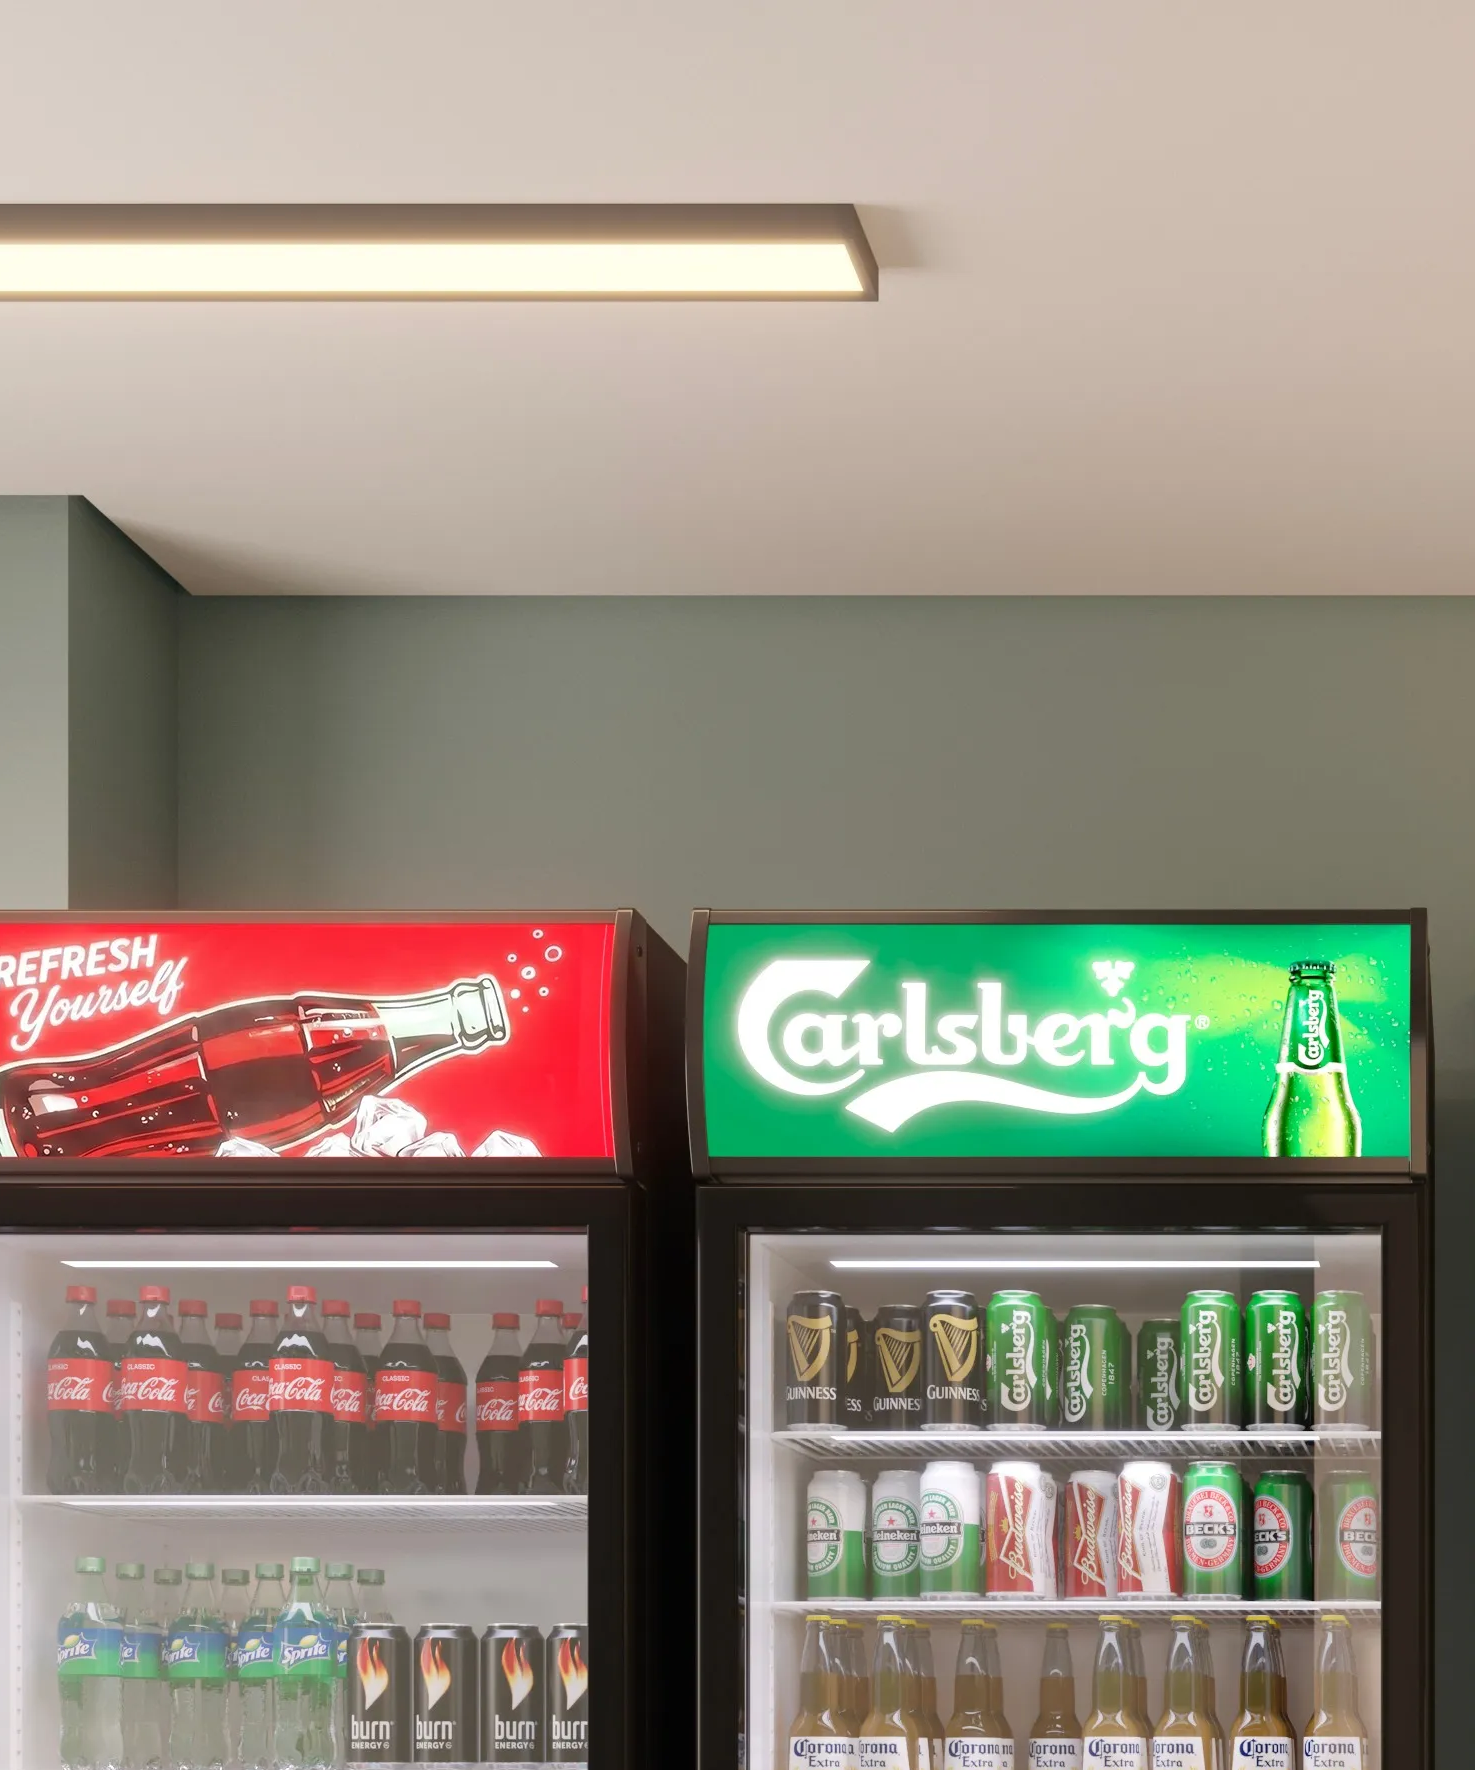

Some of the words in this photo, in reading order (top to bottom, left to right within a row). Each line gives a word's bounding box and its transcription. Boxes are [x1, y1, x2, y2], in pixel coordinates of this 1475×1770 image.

[10, 956, 188, 1051] Yourself
[737, 959, 1190, 1096] Carlsberg
[1267, 1310, 1296, 1411] Carlsberg
[927, 1385, 980, 1400] GUINNESS
[1186, 1524, 1235, 1535] BECK'S
[281, 1641, 327, 1665] Sprite
[351, 1716, 391, 1739] burn
[351, 1741, 383, 1749] ENERGY
[793, 1739, 848, 1758] Corona
[808, 1756, 840, 1768] Extra
